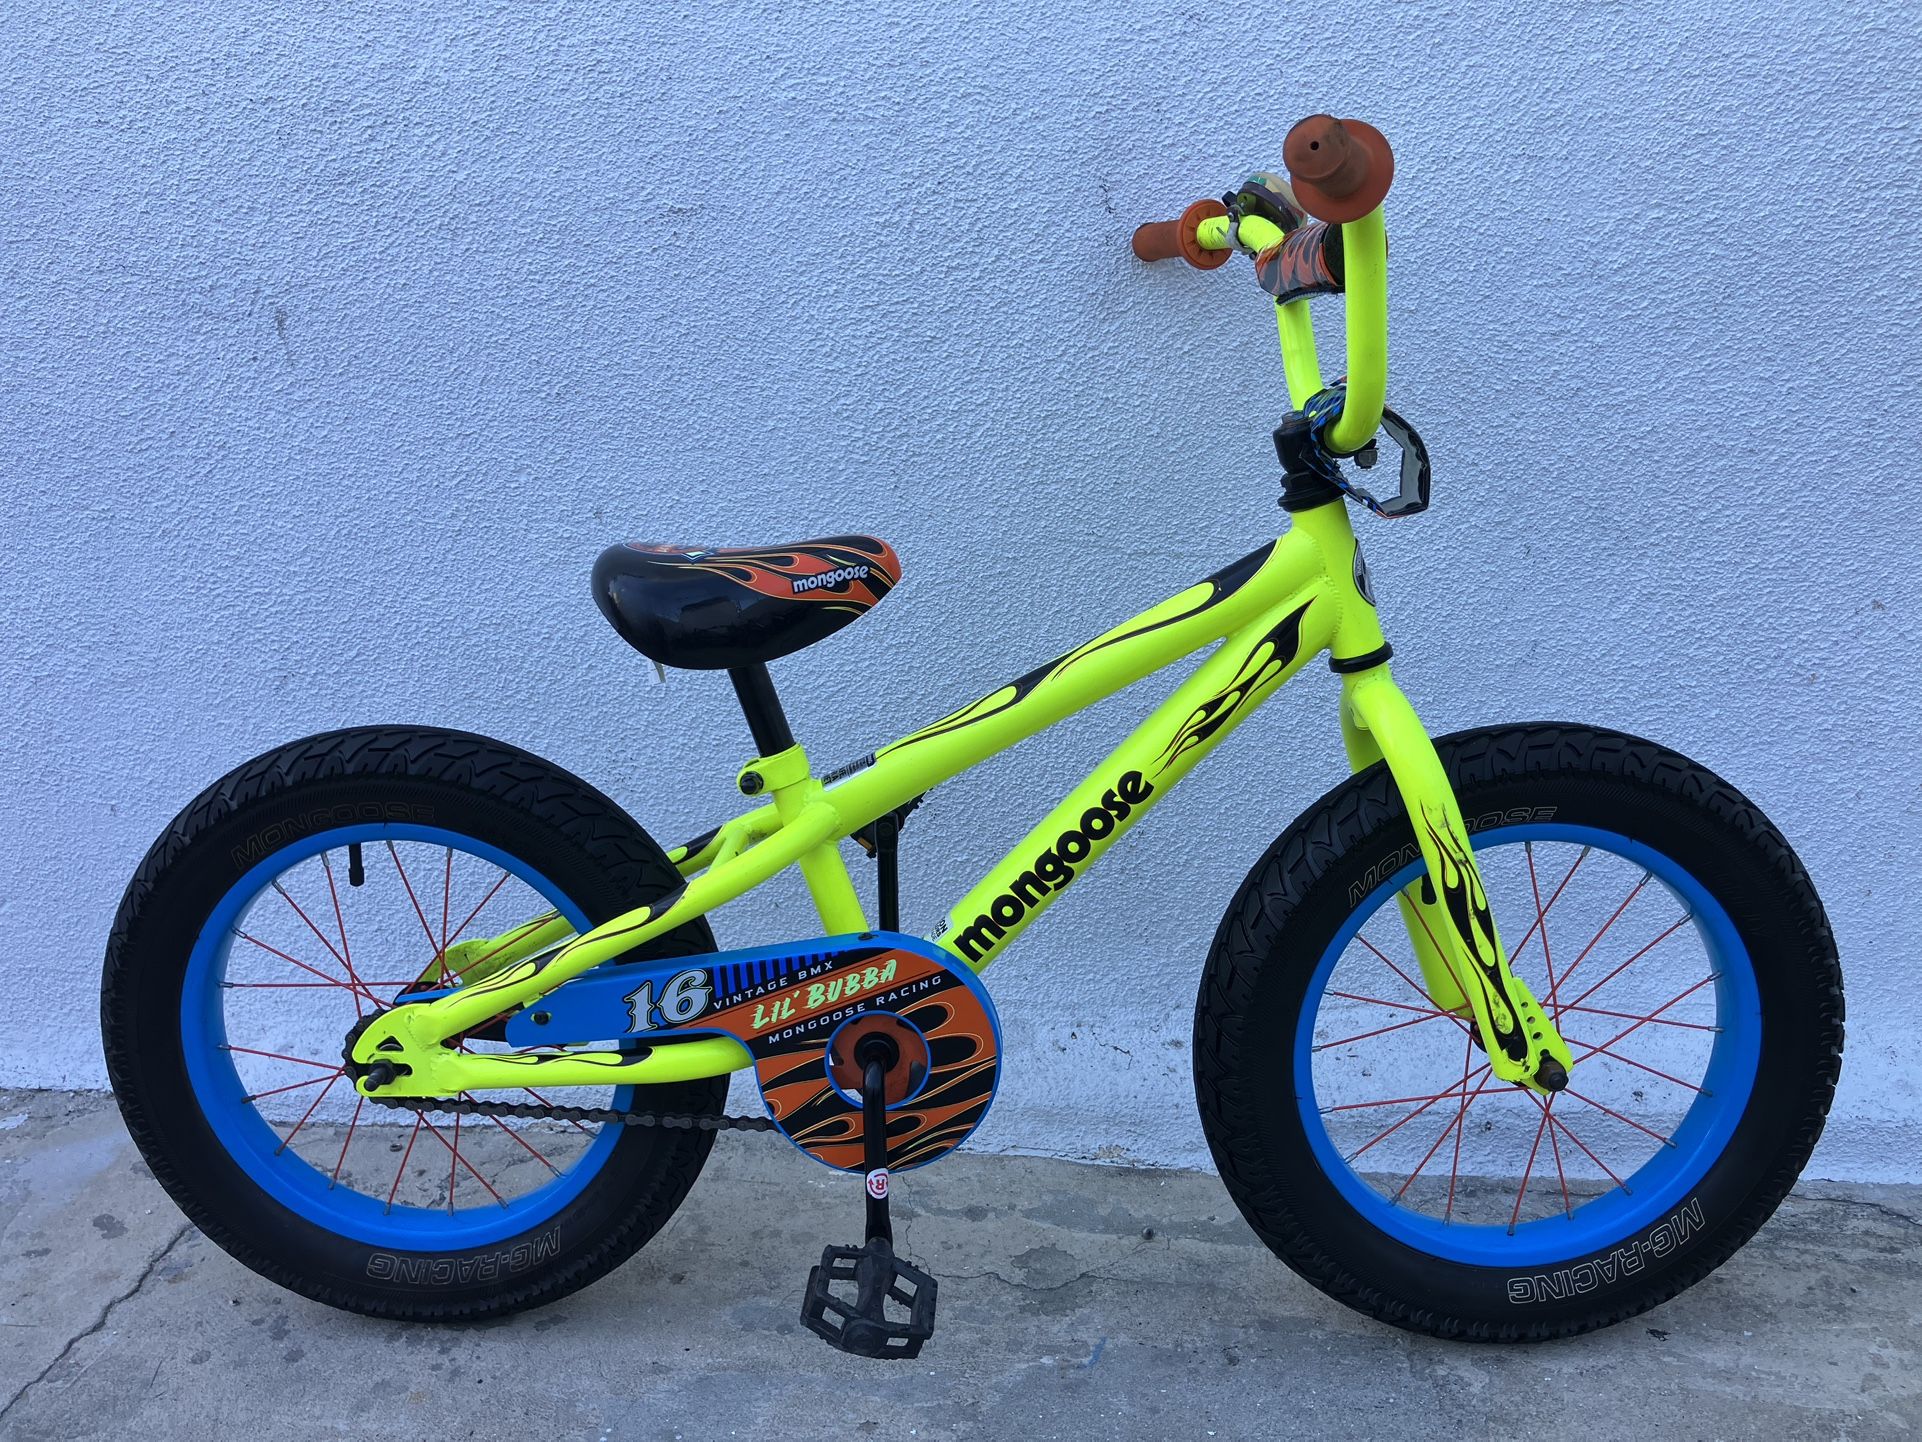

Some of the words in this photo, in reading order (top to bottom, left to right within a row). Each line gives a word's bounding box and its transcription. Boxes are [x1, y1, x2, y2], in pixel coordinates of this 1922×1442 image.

[792, 563, 870, 594] mongoose
[230, 801, 436, 870] MONGOOSE
[953, 770, 1155, 964] mongoose
[1347, 805, 1558, 908] MONOSE
[623, 968, 713, 1034] 16
[712, 977, 788, 1010] VINTAGE
[797, 960, 834, 981] BMX
[750, 991, 800, 1030] LIL'
[802, 959, 898, 1009] BUBBA
[767, 1002, 867, 1045] MONGOOSE
[875, 975, 943, 1005] RACING
